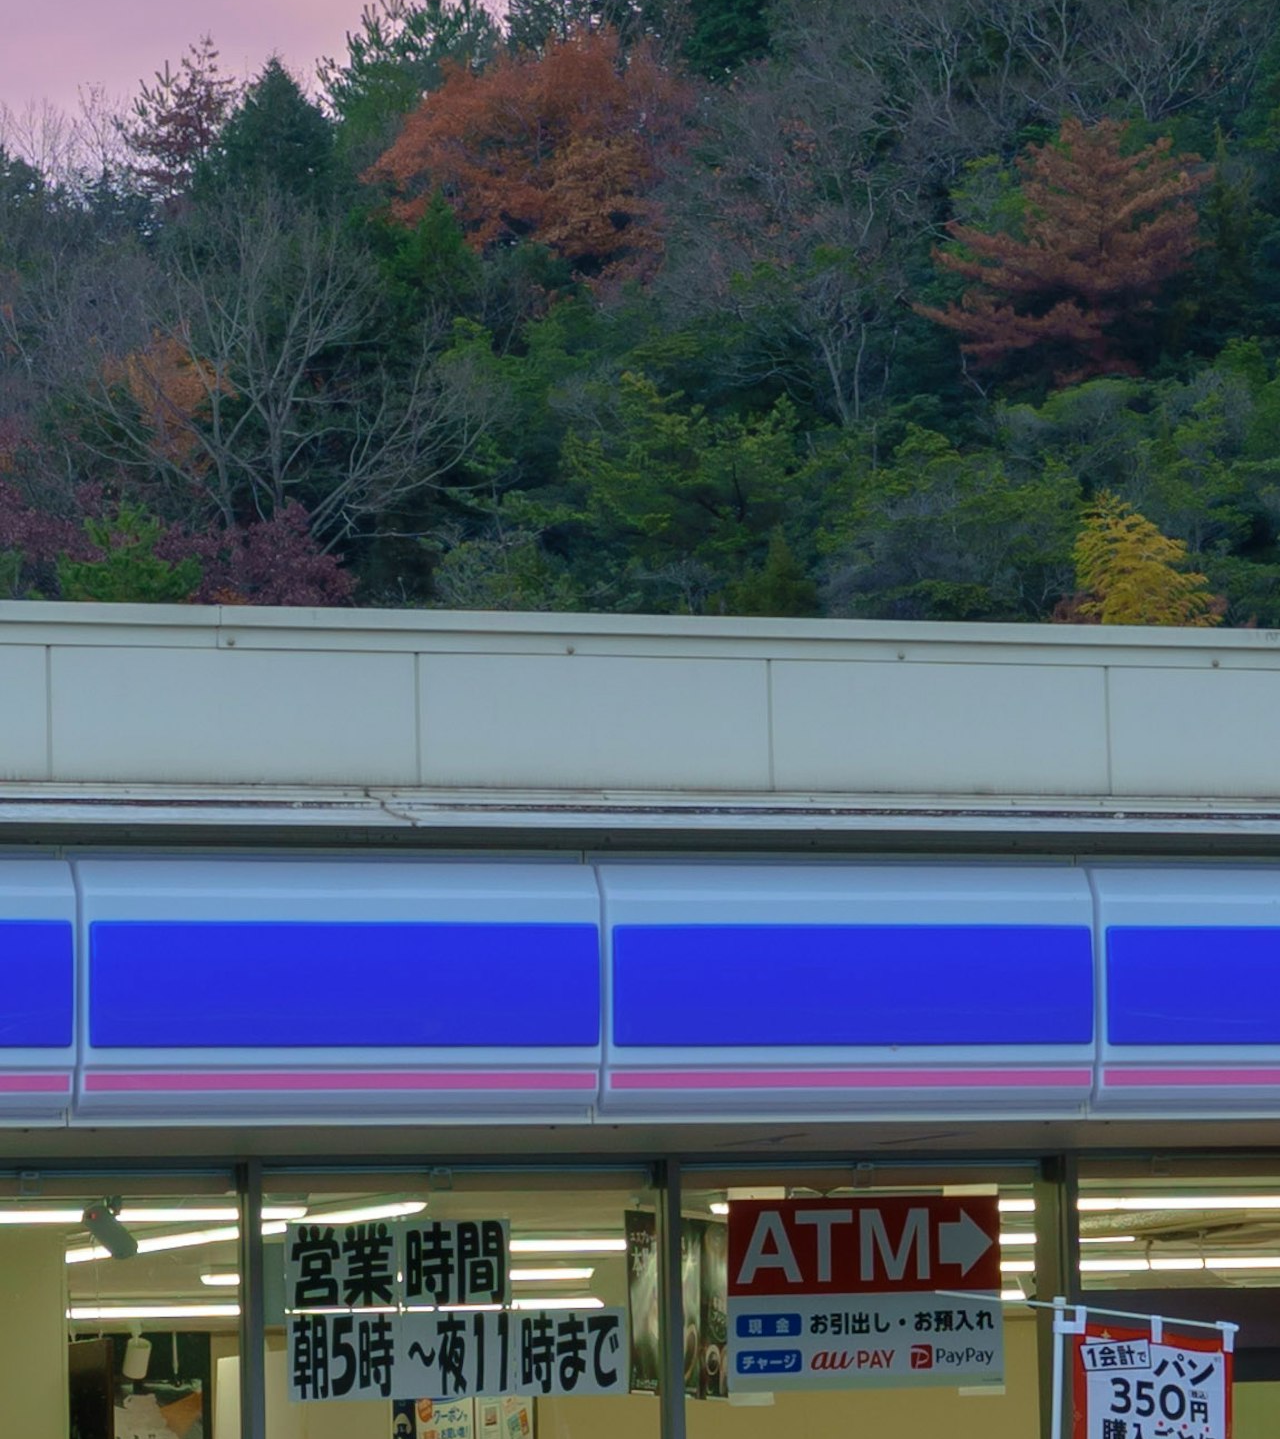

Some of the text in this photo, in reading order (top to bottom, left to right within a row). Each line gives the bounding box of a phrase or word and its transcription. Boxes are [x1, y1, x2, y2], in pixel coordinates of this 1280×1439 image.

[291, 1220, 506, 1307] 営業時間
[735, 1207, 931, 1284] ATM
[747, 1309, 995, 1336] 現金 お引出し・お預入れ
[742, 1353, 798, 1370] チャージ
[857, 1349, 896, 1370] PAY
[935, 1347, 995, 1366] PayPay
[1086, 1344, 1215, 1386] 1会計で パン
[1110, 1376, 1209, 1424] 350円
